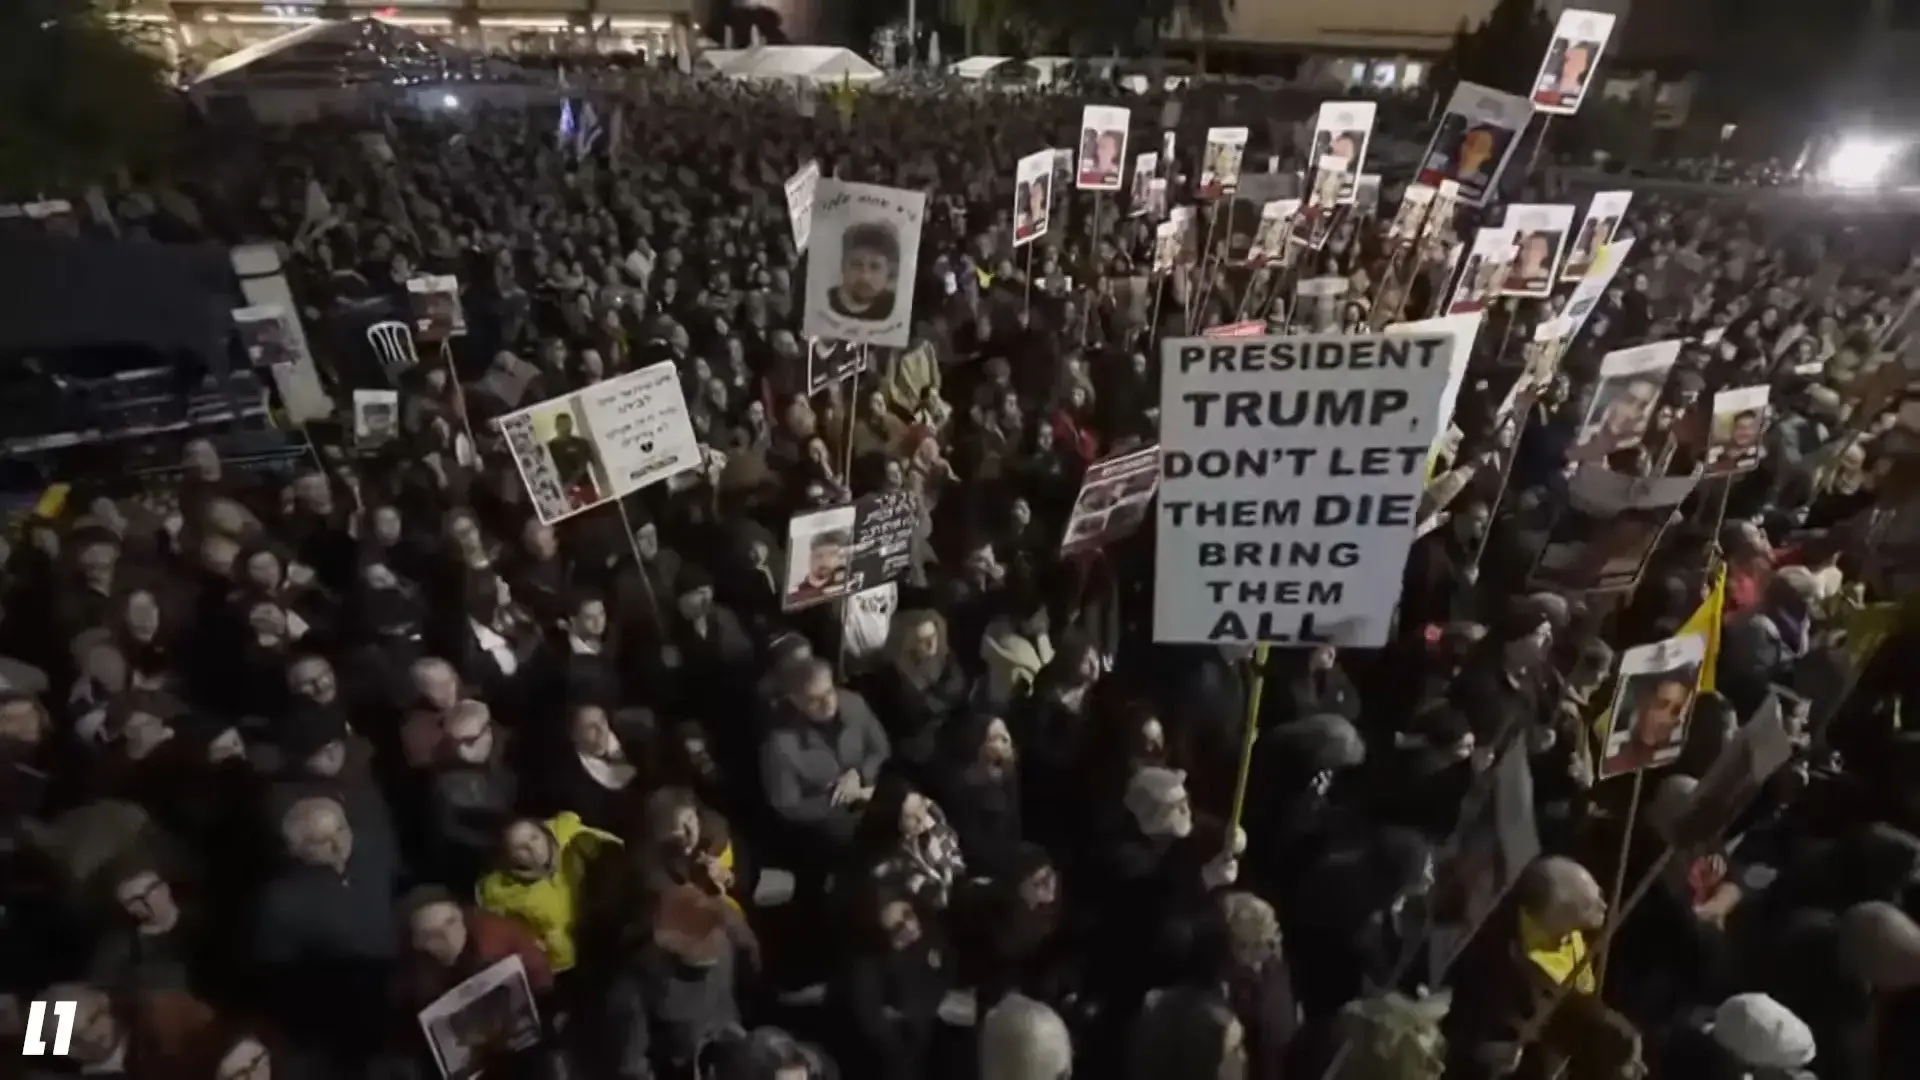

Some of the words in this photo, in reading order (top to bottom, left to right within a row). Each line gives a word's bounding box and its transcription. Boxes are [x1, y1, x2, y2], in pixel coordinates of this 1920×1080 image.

[1180, 339, 1444, 373] PRESIDENT
[1183, 389, 1419, 431] TRUMP,
[1163, 447, 1317, 479] DON'T
[1329, 446, 1430, 476] LET
[1163, 500, 1301, 527] THEM
[1314, 494, 1415, 527] DIE
[1199, 542, 1360, 567] BRING
[1206, 580, 1344, 605] THEM
[1207, 609, 1335, 642] ALL
